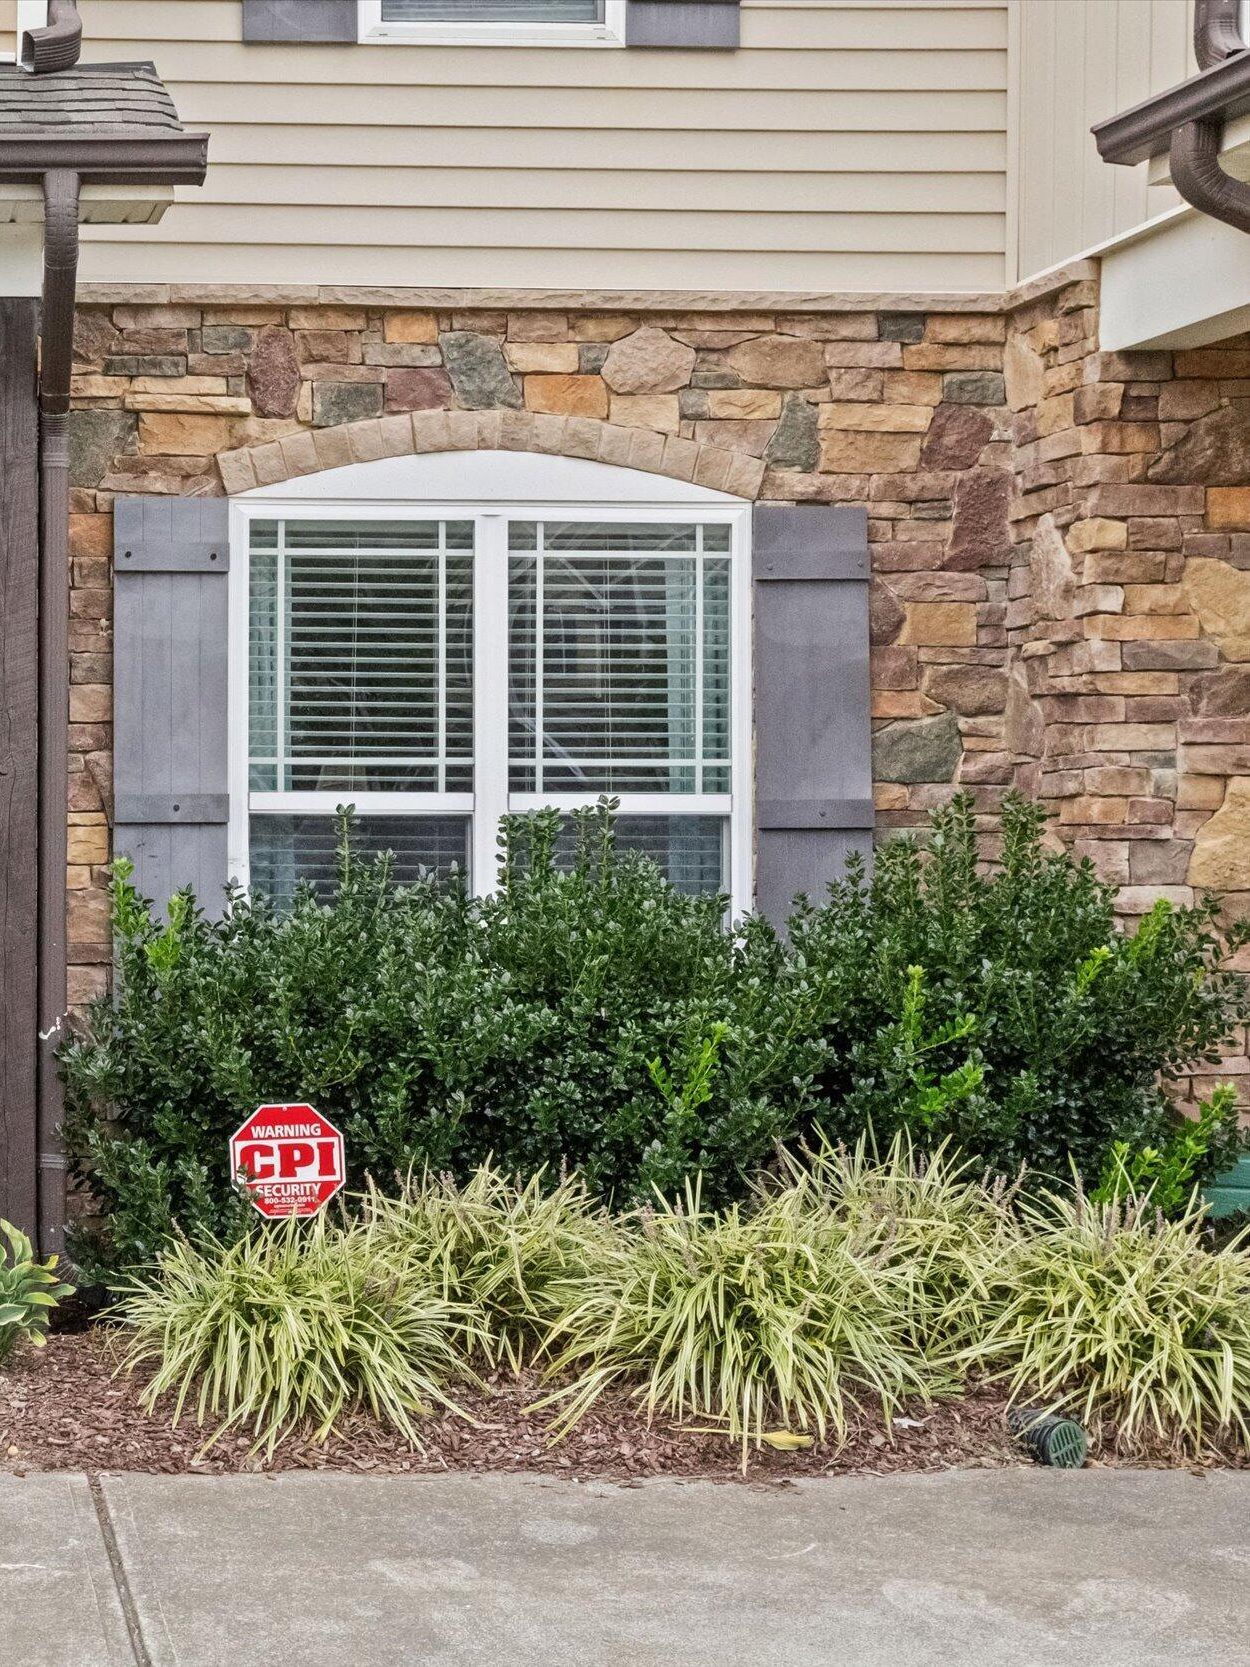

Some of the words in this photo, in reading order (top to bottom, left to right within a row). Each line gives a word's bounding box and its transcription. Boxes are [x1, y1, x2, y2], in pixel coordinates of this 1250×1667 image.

[251, 1123, 321, 1138] WARNING
[240, 1141, 336, 1180] CPI
[255, 1183, 322, 1197] SECURITY
